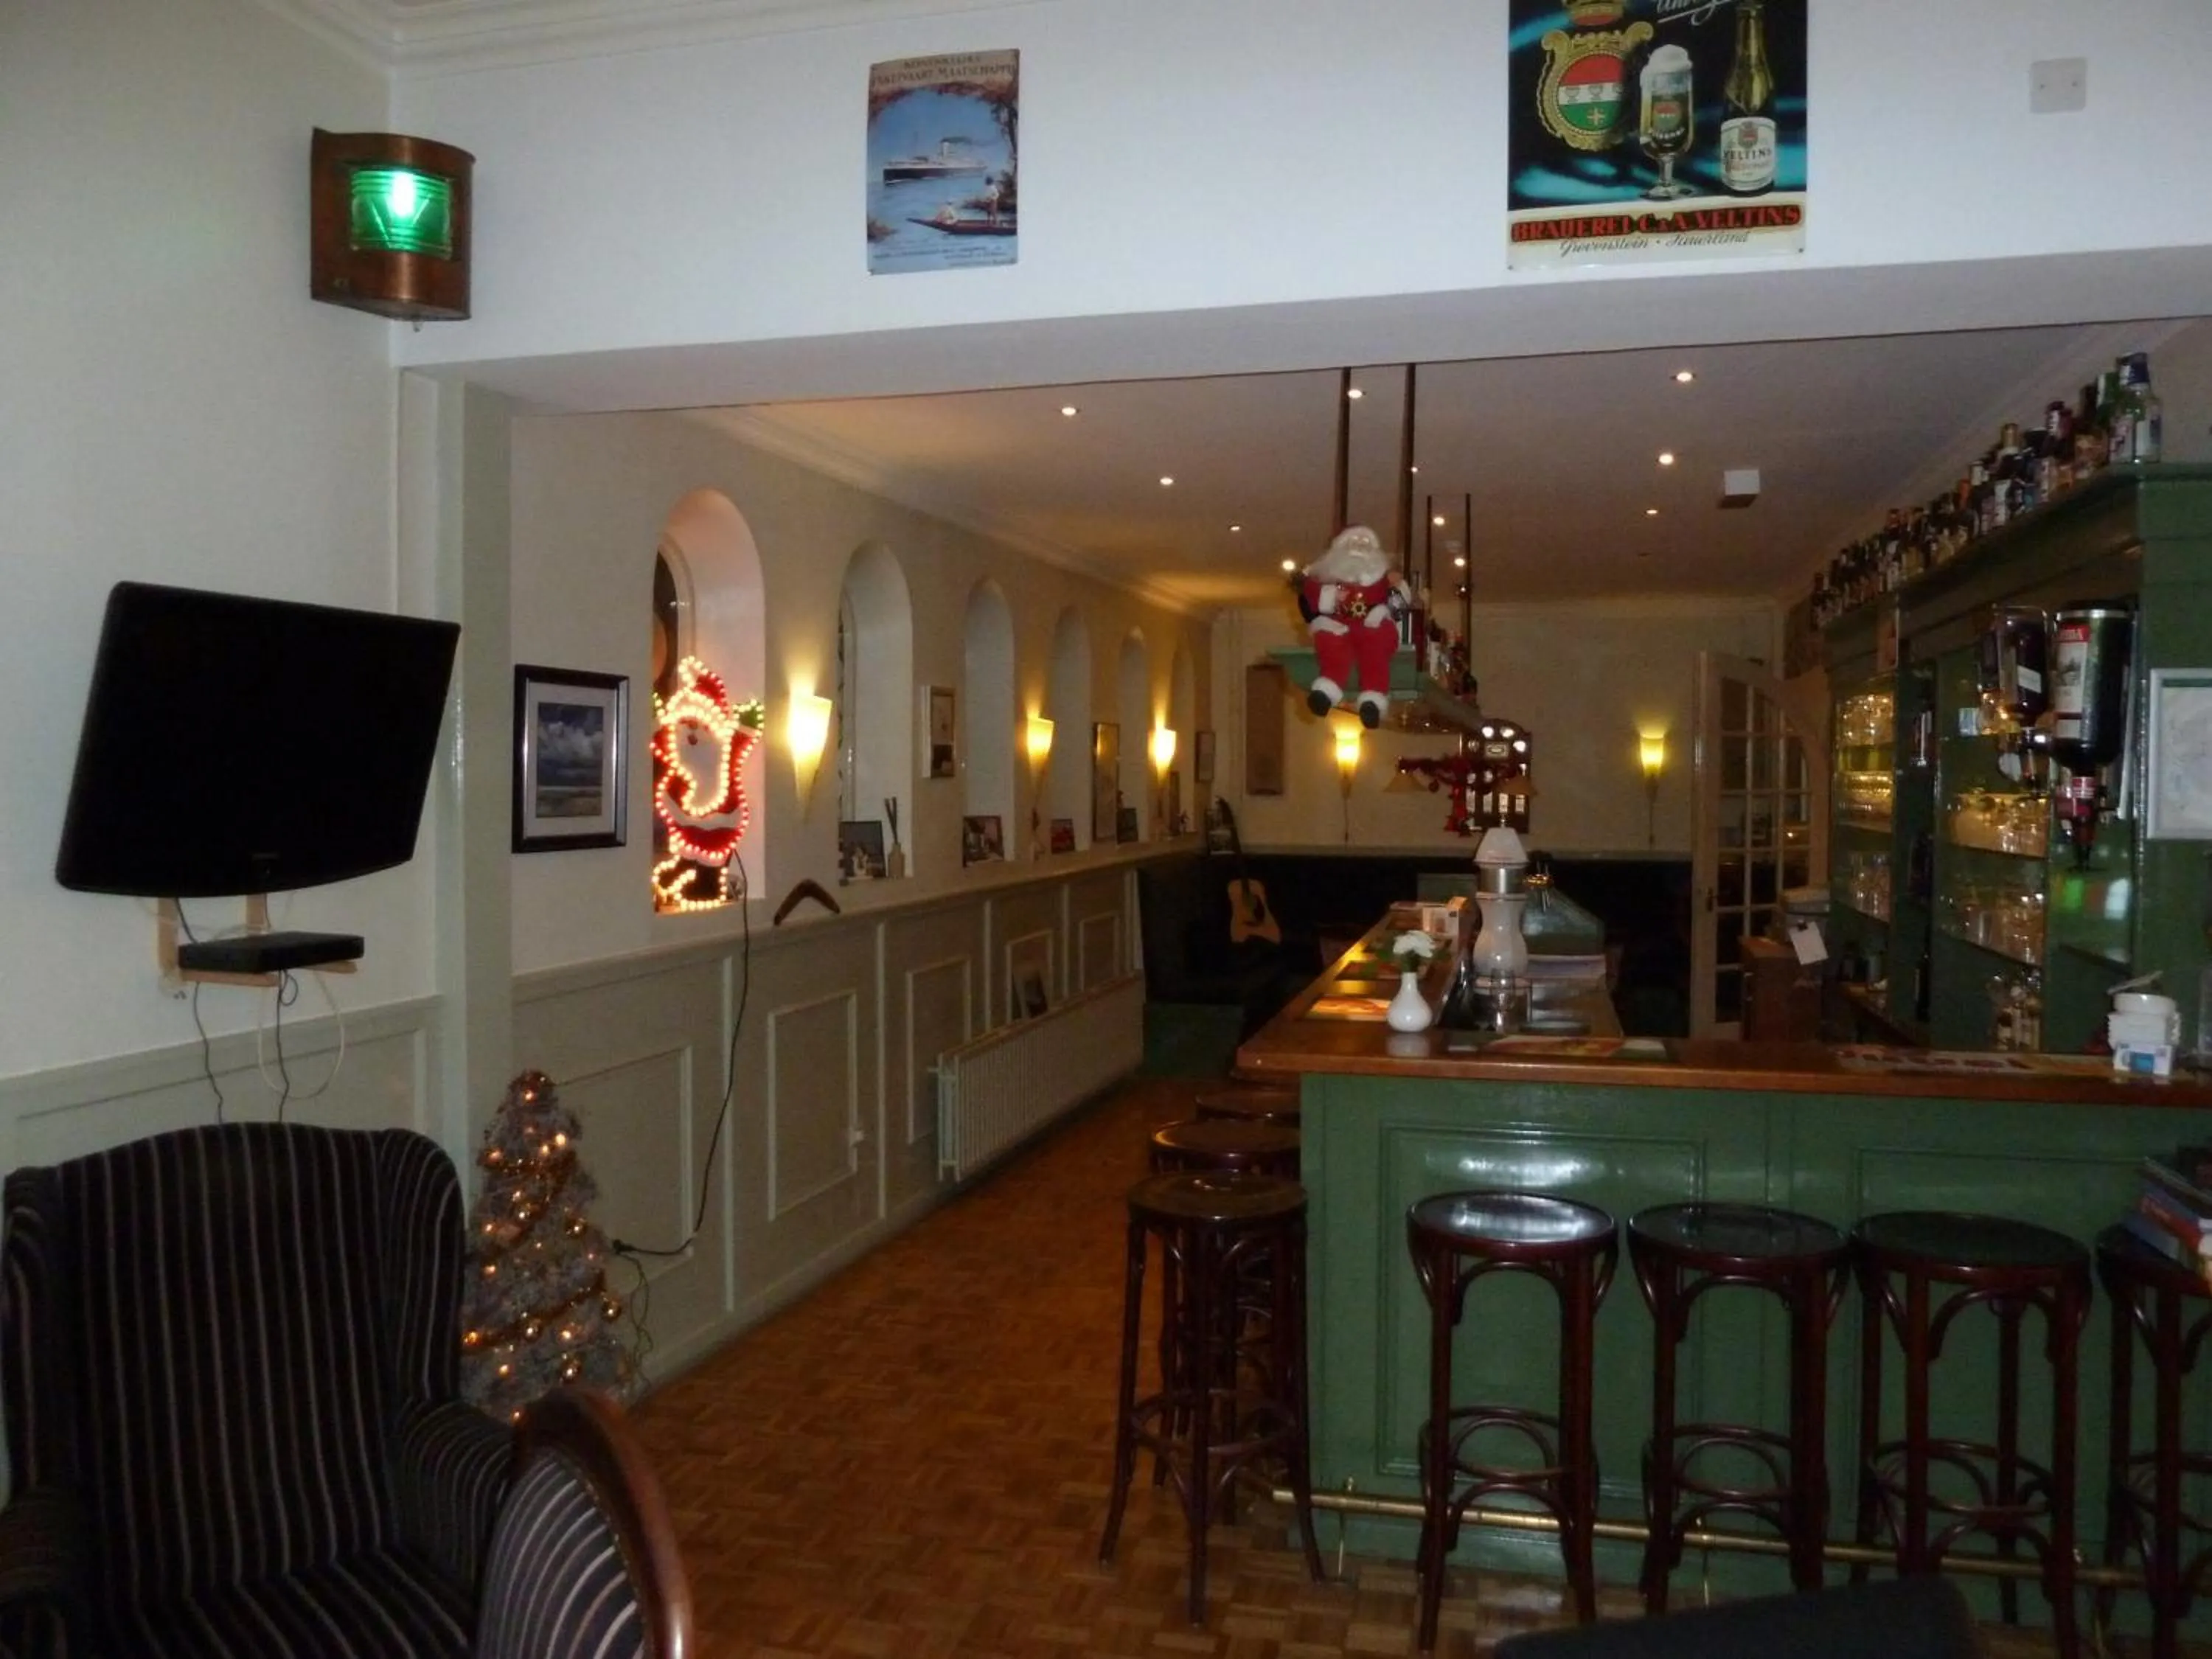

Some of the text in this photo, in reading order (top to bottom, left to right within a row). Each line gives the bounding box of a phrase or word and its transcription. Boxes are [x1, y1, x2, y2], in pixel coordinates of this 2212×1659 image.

[1724, 148, 1773, 161] VELTINS
[1512, 216, 1630, 240] BRAUEREI
[1694, 206, 1799, 228] VELTINS
[1665, 231, 1750, 246] Sauerland
